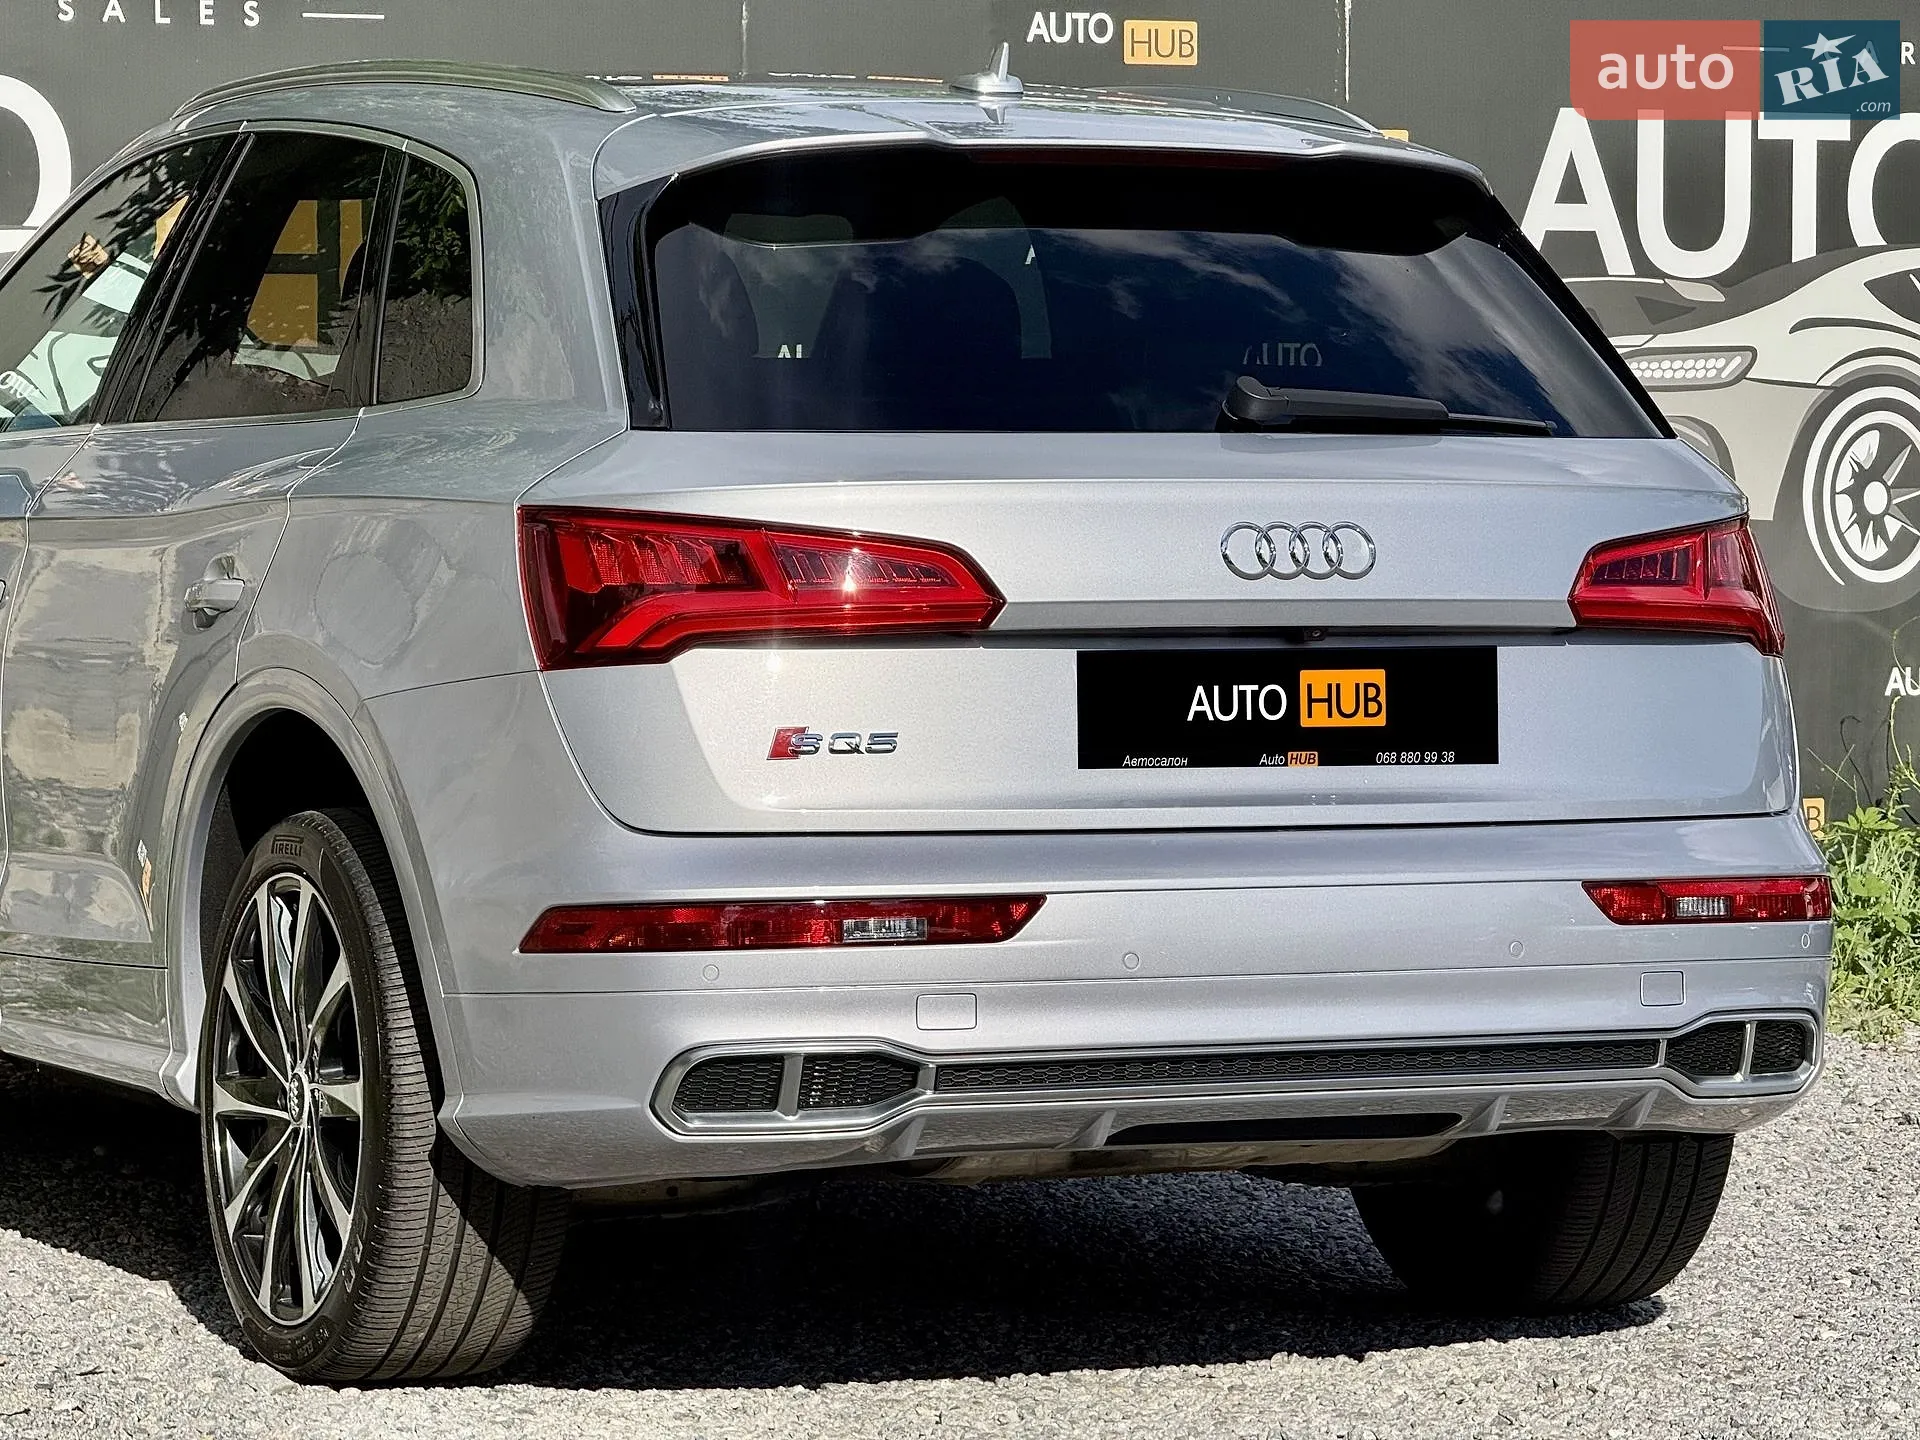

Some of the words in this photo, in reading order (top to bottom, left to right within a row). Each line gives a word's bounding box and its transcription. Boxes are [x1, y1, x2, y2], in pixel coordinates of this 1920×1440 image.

[57, 0, 261, 27] SALES
[1026, 11, 1114, 44] AUTO
[1130, 28, 1195, 58] HUB
[1186, 684, 1288, 722] AUTO
[1306, 682, 1384, 720] HUB
[785, 731, 899, 756] SQ5
[1122, 755, 1189, 768] Автосалон
[1258, 753, 1286, 766] Auto
[1289, 753, 1317, 765] HUB
[1375, 752, 1397, 764] 068
[1399, 751, 1421, 764] 880
[1423, 751, 1438, 763] 99
[1440, 751, 1455, 763] 38
[270, 834, 304, 857] PIRELLI
